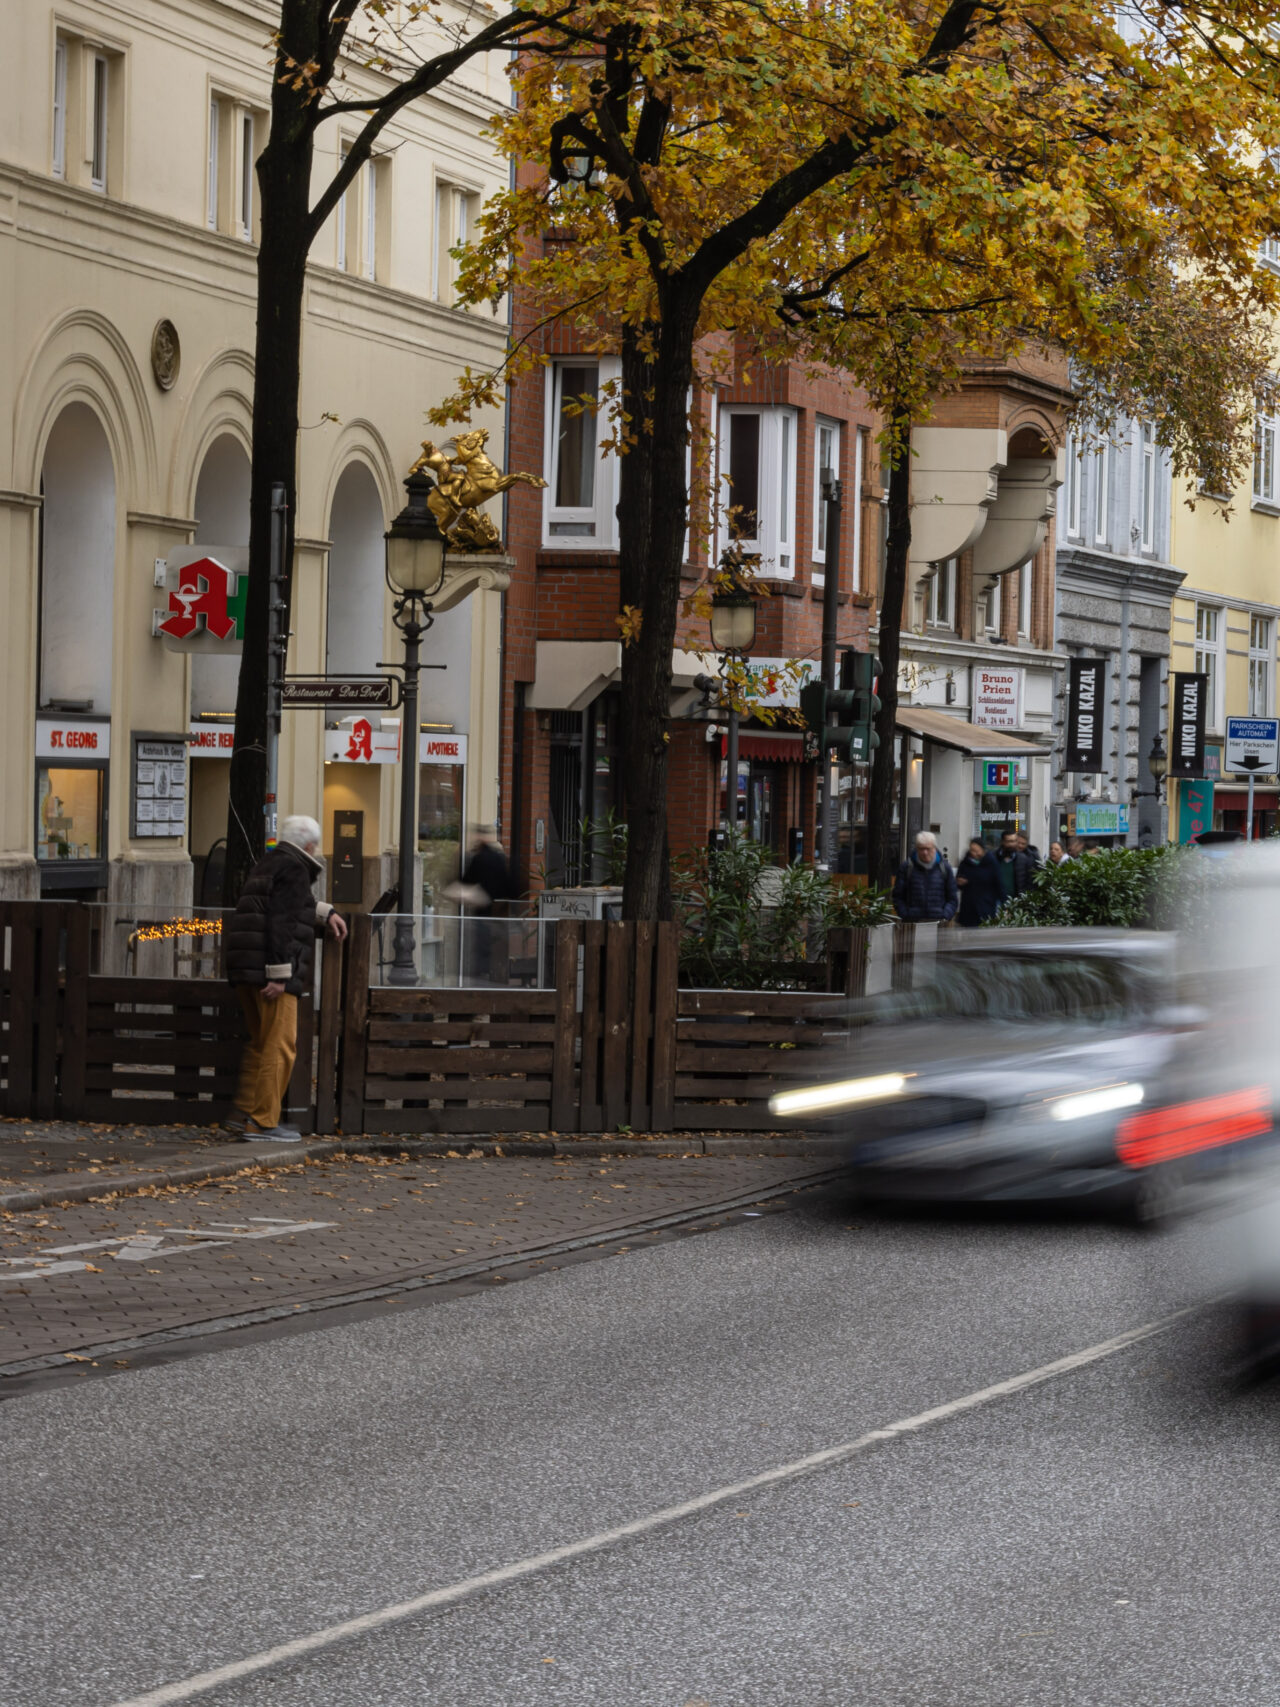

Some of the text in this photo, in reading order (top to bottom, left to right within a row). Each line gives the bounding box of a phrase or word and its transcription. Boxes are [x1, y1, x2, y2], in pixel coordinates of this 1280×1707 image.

[981, 673, 1013, 683] Bruno
[283, 683, 387, 700] Restaurant Das Dorf
[983, 684, 1011, 694] Prien
[1077, 668, 1096, 749] NIKO KAZAL
[1181, 681, 1198, 757] NIKO KAZAL
[1231, 722, 1274, 730] PARKSCHEIN-
[51, 731, 98, 749] ST. GEORG
[1243, 740, 1275, 748] Parkschein
[427, 741, 459, 756] APOTHEKE
[1187, 790, 1204, 812] 47
